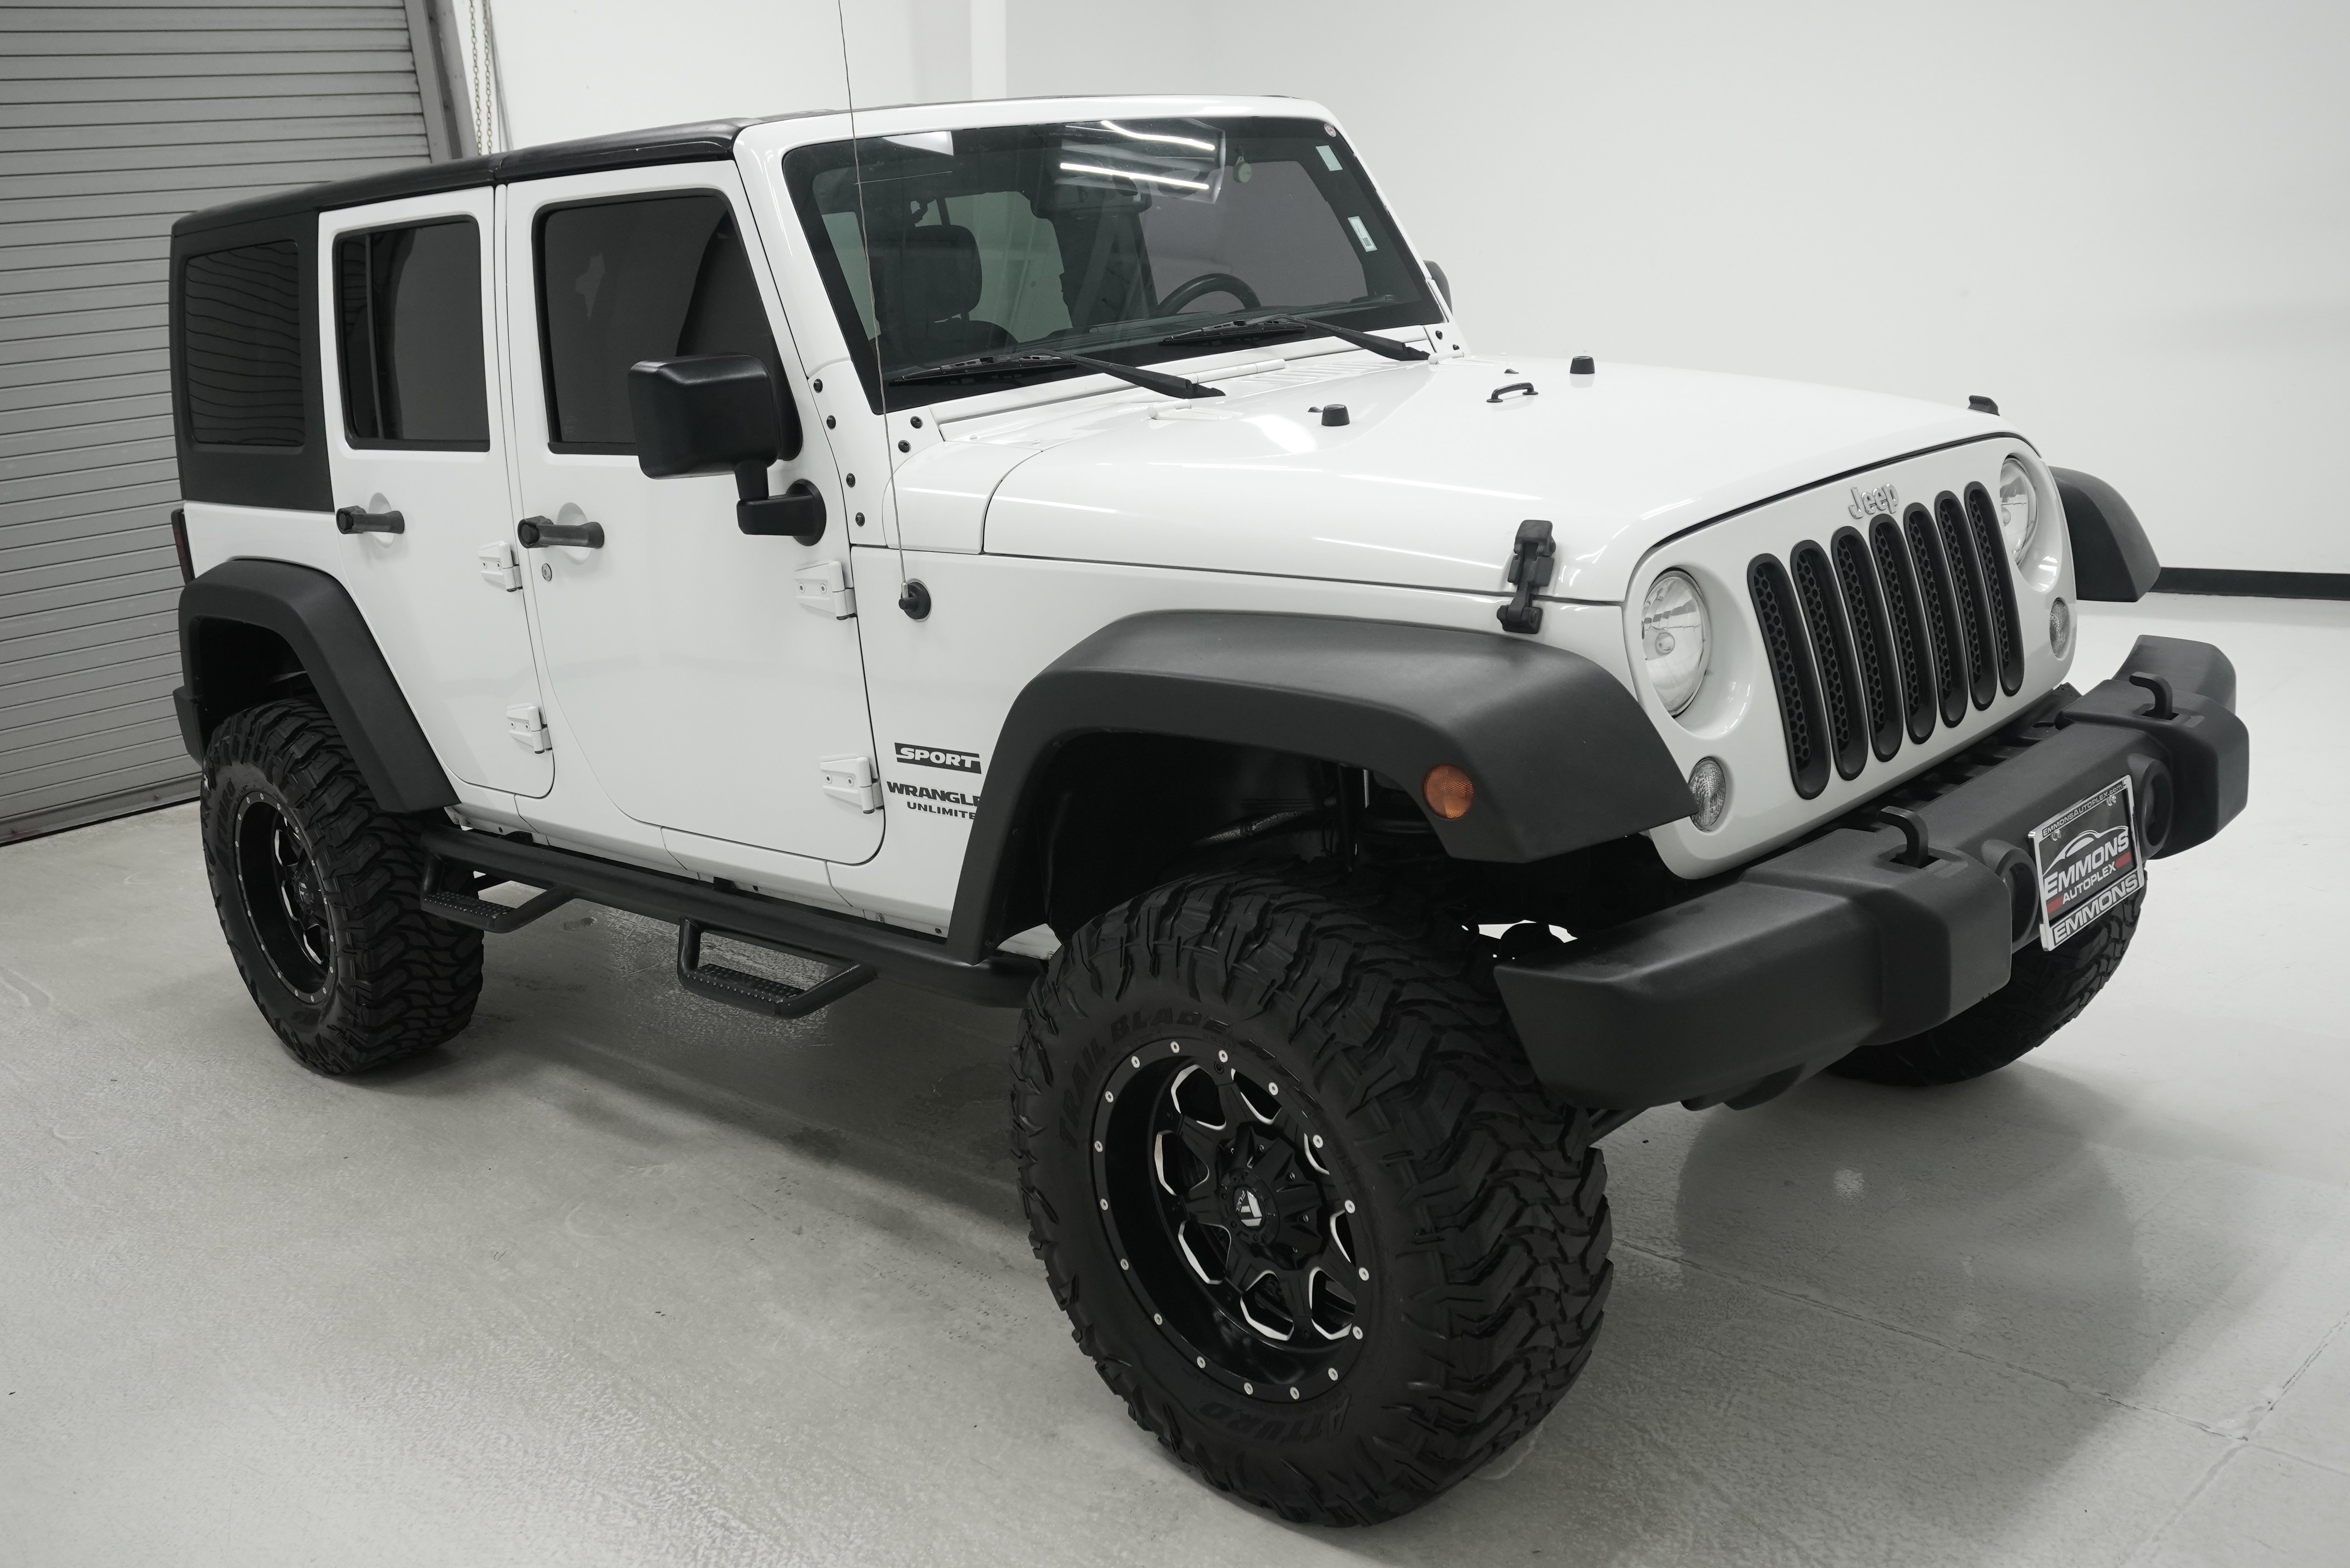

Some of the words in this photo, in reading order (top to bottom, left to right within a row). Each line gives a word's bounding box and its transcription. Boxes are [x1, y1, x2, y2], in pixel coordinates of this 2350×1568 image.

[1848, 483, 1899, 519] Jeep
[900, 747, 980, 768] SPORT
[2043, 784, 2123, 837] EMMONSAUTOPLEX.com
[2044, 833, 2129, 901] EMMONS
[2062, 861, 2117, 905] AUTOPLEX
[2054, 874, 2139, 945] EMMONS
[1059, 1037, 1106, 1150] TRAIL
[1111, 1006, 1230, 1043] BLADE
[1235, 1190, 1246, 1212] FUEL
[1199, 1394, 1352, 1445] ATTURO
